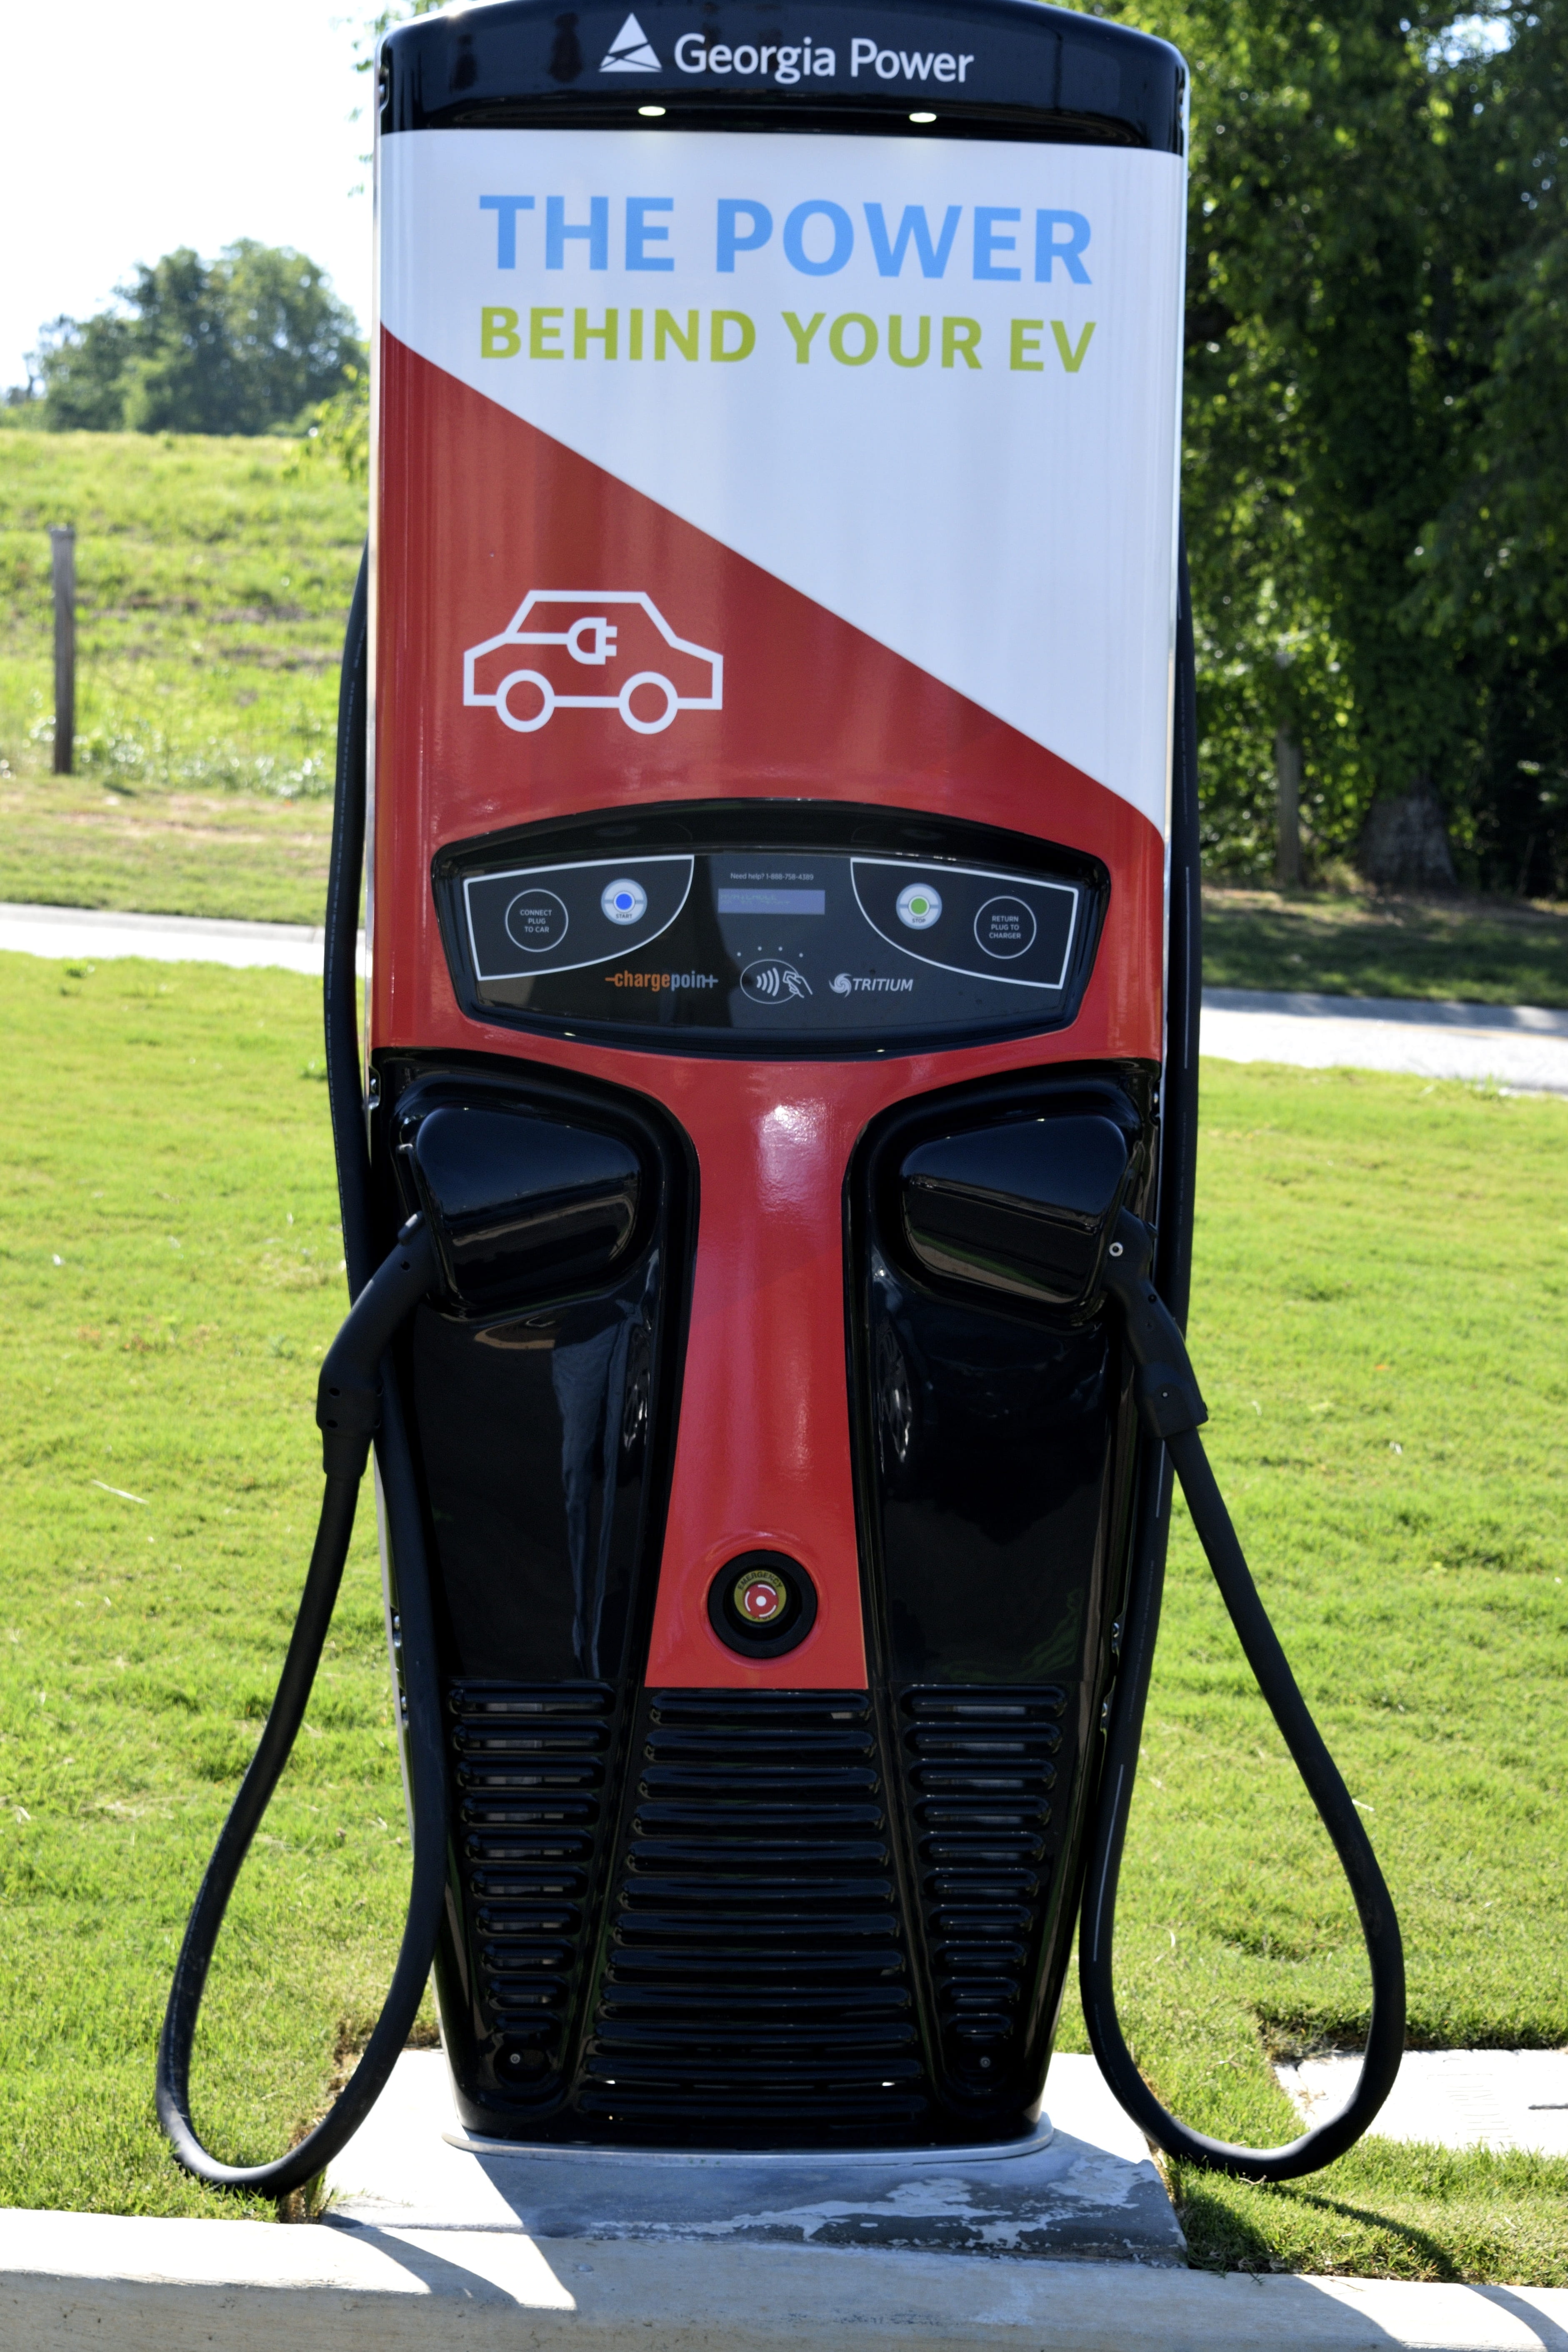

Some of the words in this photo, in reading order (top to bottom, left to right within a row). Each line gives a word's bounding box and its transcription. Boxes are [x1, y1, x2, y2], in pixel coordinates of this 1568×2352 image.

[674, 33, 835, 84] Georgia
[851, 38, 975, 82] Power
[479, 195, 675, 272] THE
[716, 198, 1092, 285] POWER
[481, 307, 756, 362] BEHIND
[782, 312, 982, 369] YOUR
[1010, 319, 1096, 372] EV
[748, 872, 765, 881] help?
[853, 978, 913, 992] TRITIUM
[738, 1572, 783, 1590] EMERGENCY
